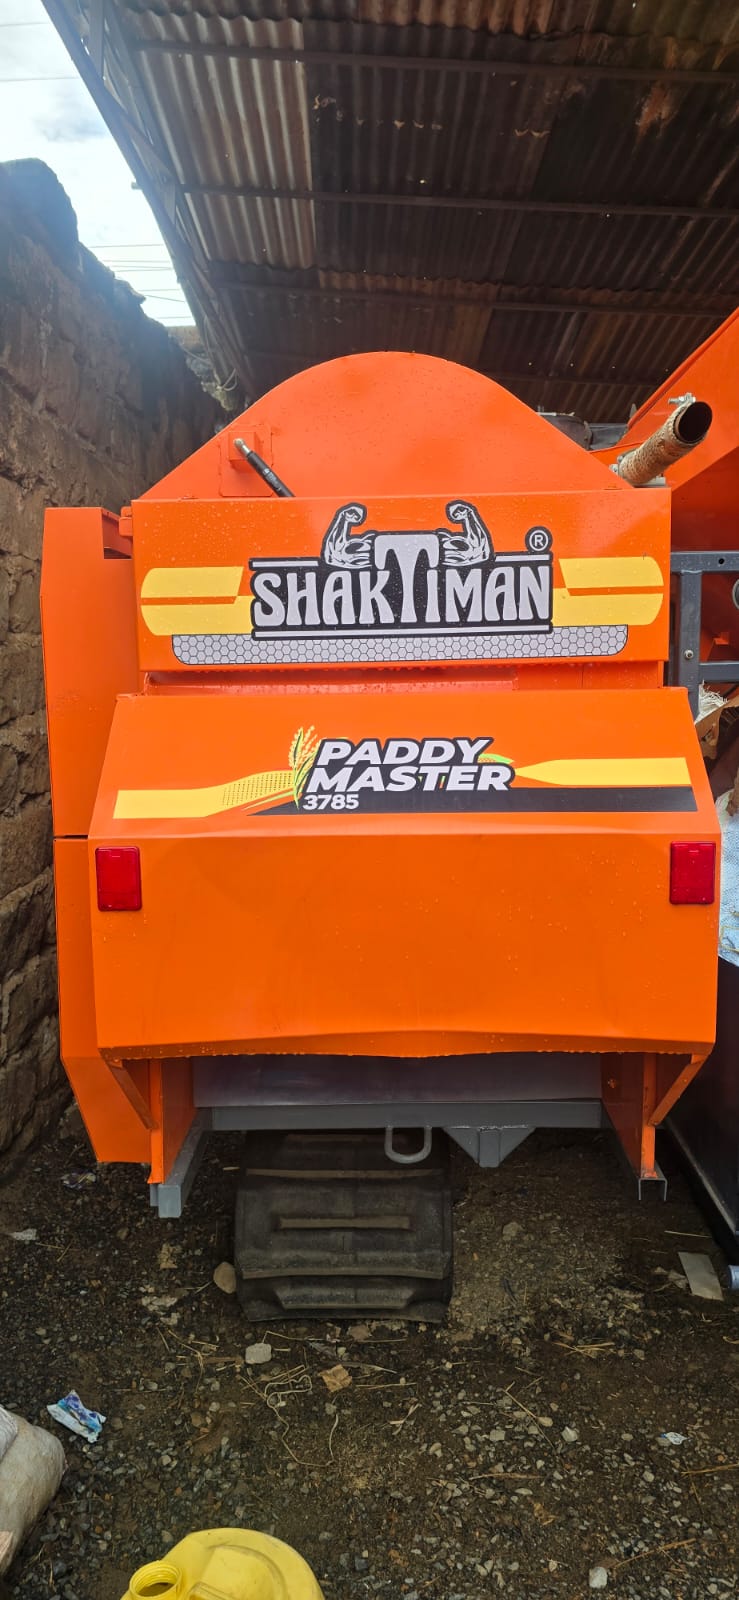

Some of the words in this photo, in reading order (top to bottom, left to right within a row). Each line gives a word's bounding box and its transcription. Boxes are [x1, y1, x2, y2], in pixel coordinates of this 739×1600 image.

[253, 534, 550, 627] SHAKTIMAN
[316, 739, 490, 766] PADDY
[305, 765, 512, 793] MASTER
[302, 794, 359, 811] 3785
